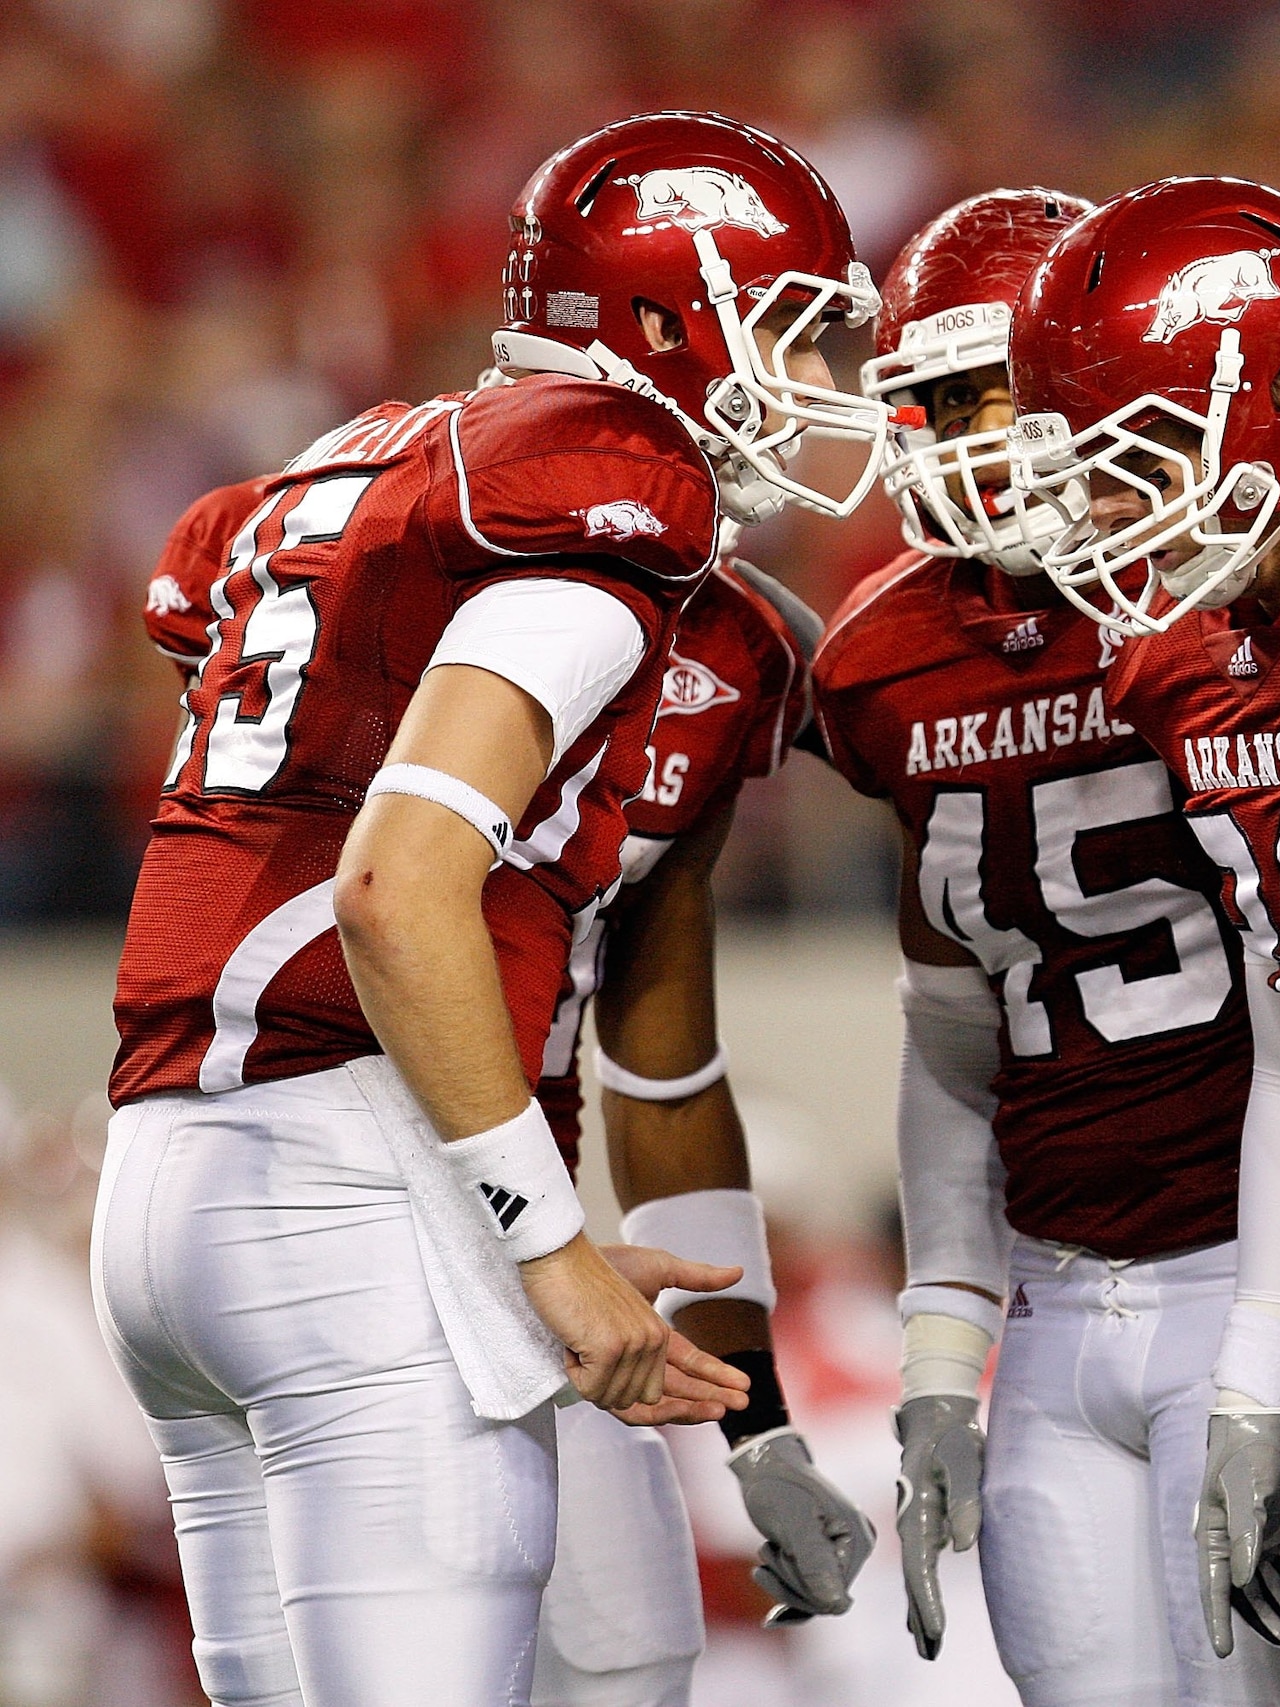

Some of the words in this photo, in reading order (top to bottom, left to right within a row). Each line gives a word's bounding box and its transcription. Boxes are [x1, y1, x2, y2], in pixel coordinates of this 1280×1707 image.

[936, 310, 975, 334] HOGS
[162, 474, 377, 793] 15
[1003, 634, 1044, 653] adidas
[672, 669, 701, 703] SEC
[917, 758, 1233, 1057] 45
